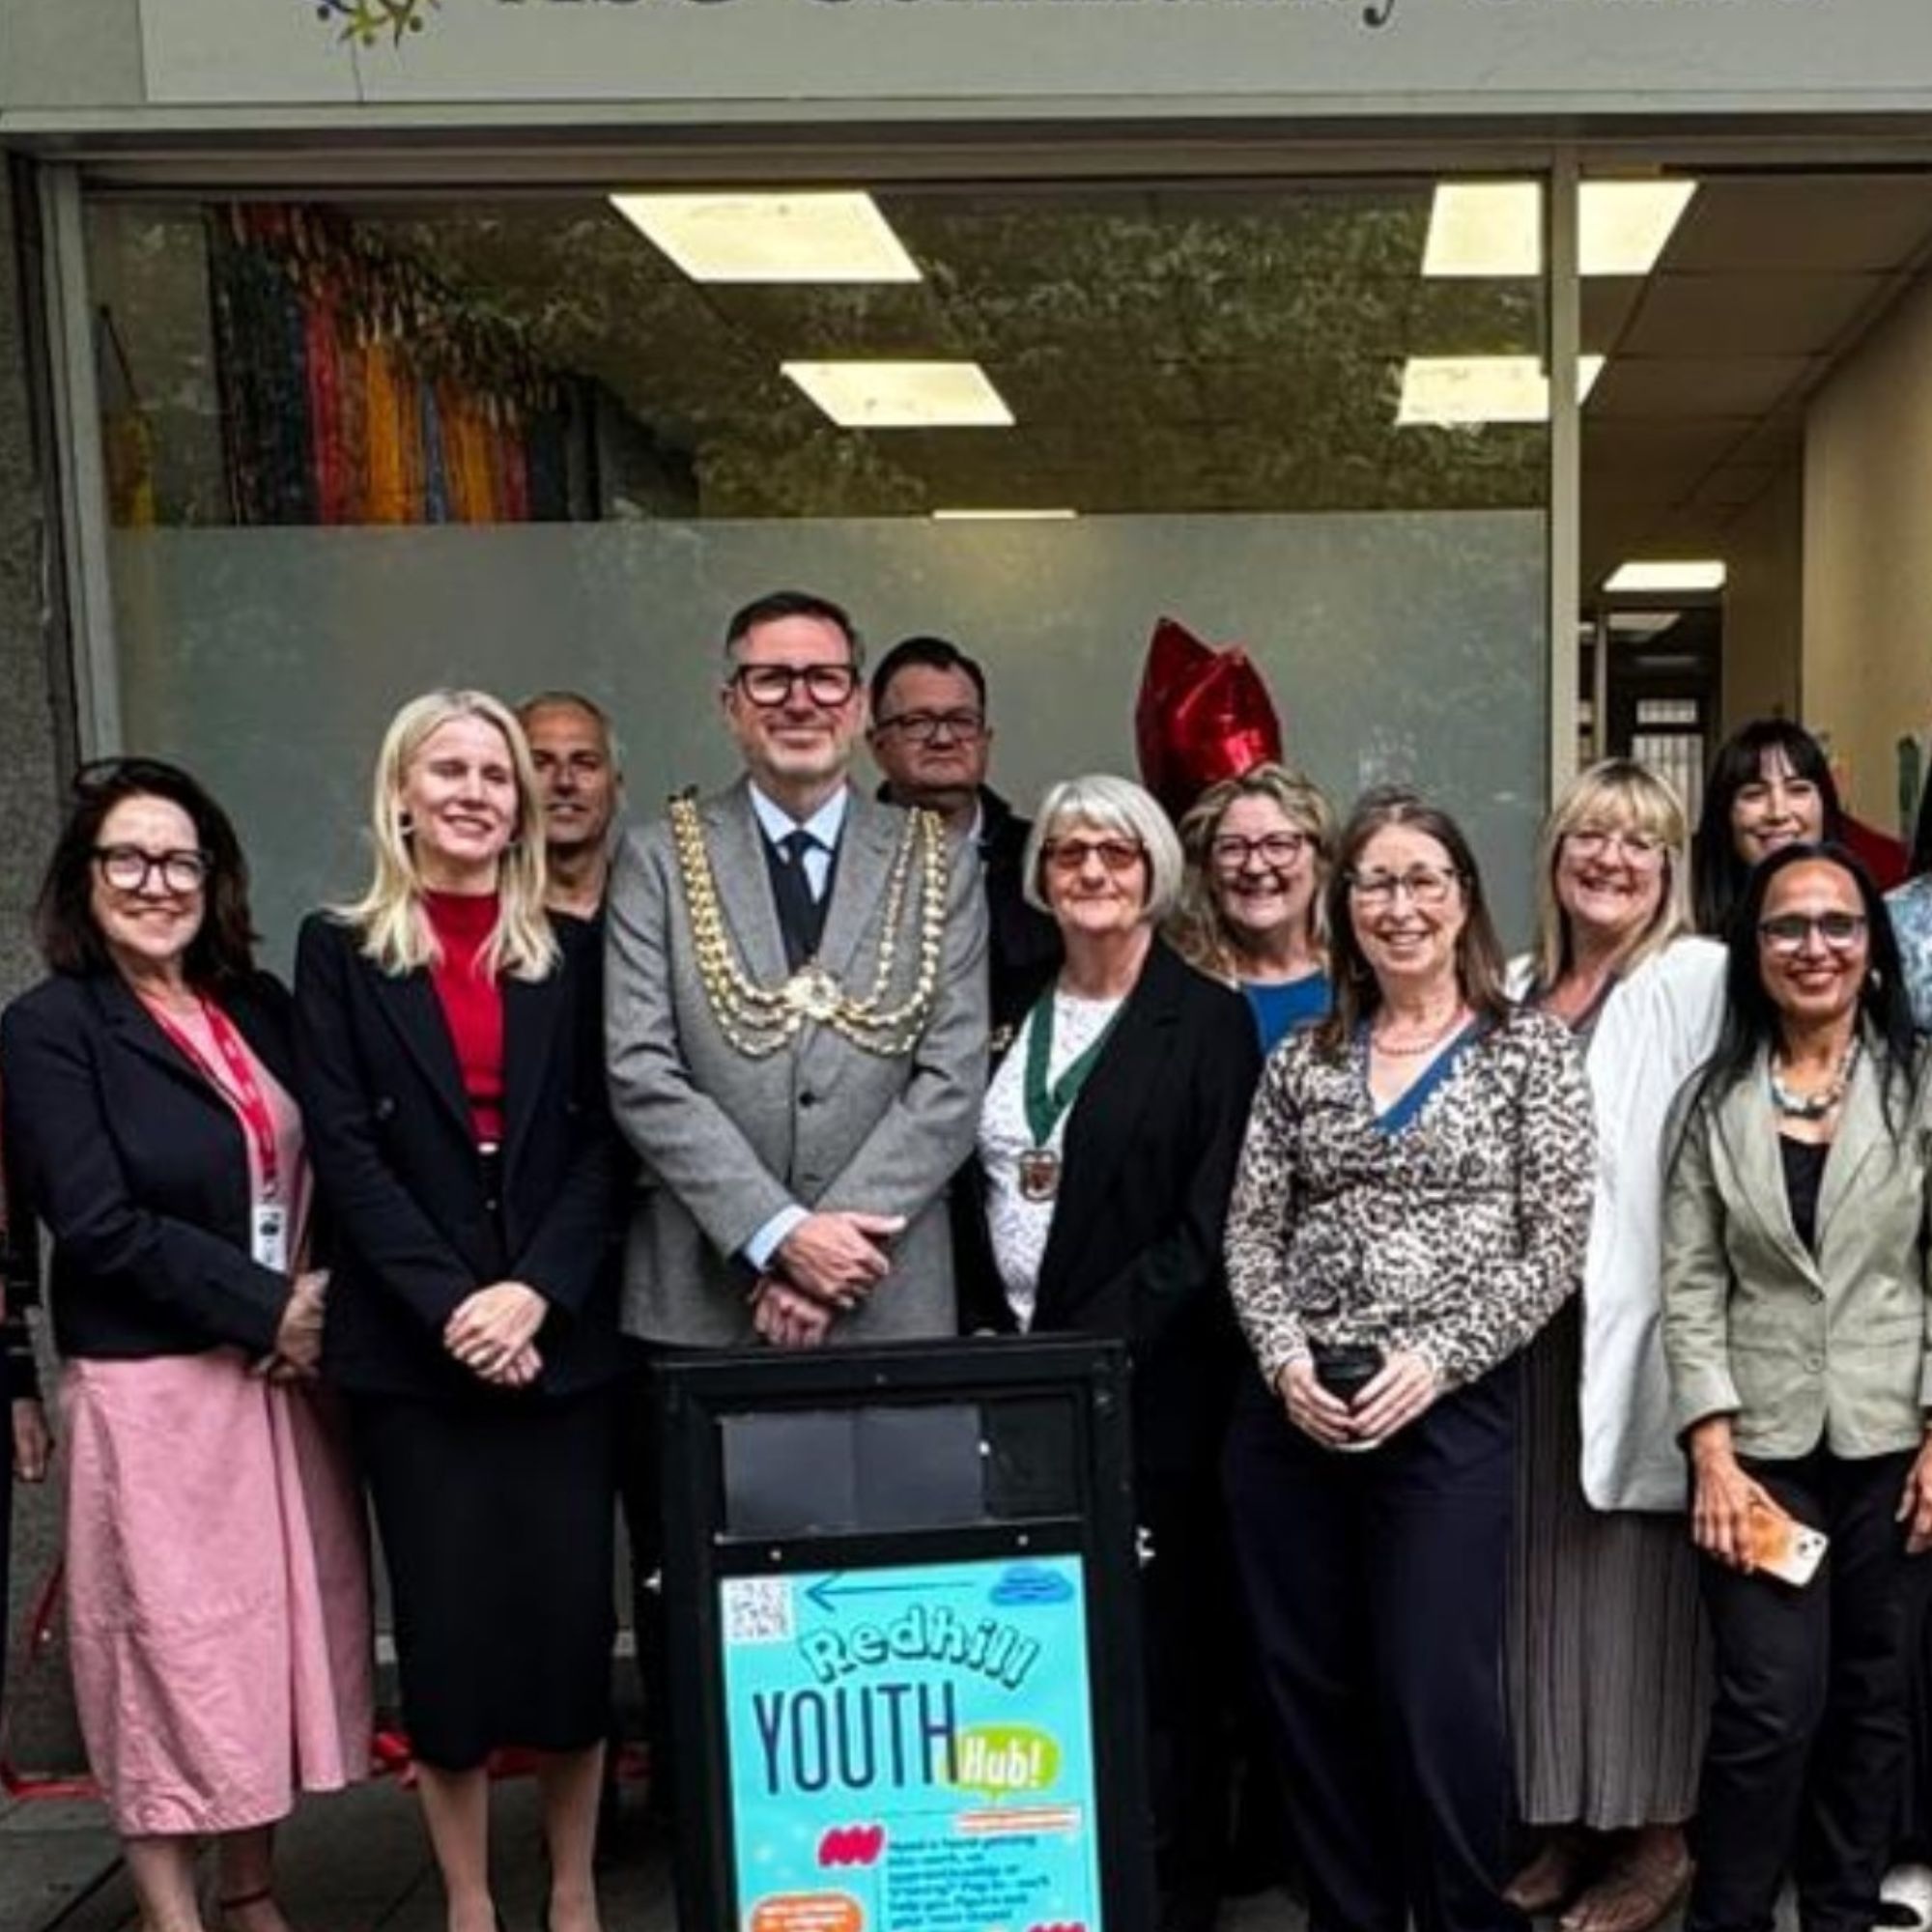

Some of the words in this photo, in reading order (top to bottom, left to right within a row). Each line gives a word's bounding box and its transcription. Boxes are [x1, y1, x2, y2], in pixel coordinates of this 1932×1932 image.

[800, 1605, 1039, 1690] Redhill
[753, 1680, 958, 1796] YOUTH
[960, 1735, 1041, 1788] Hub!
